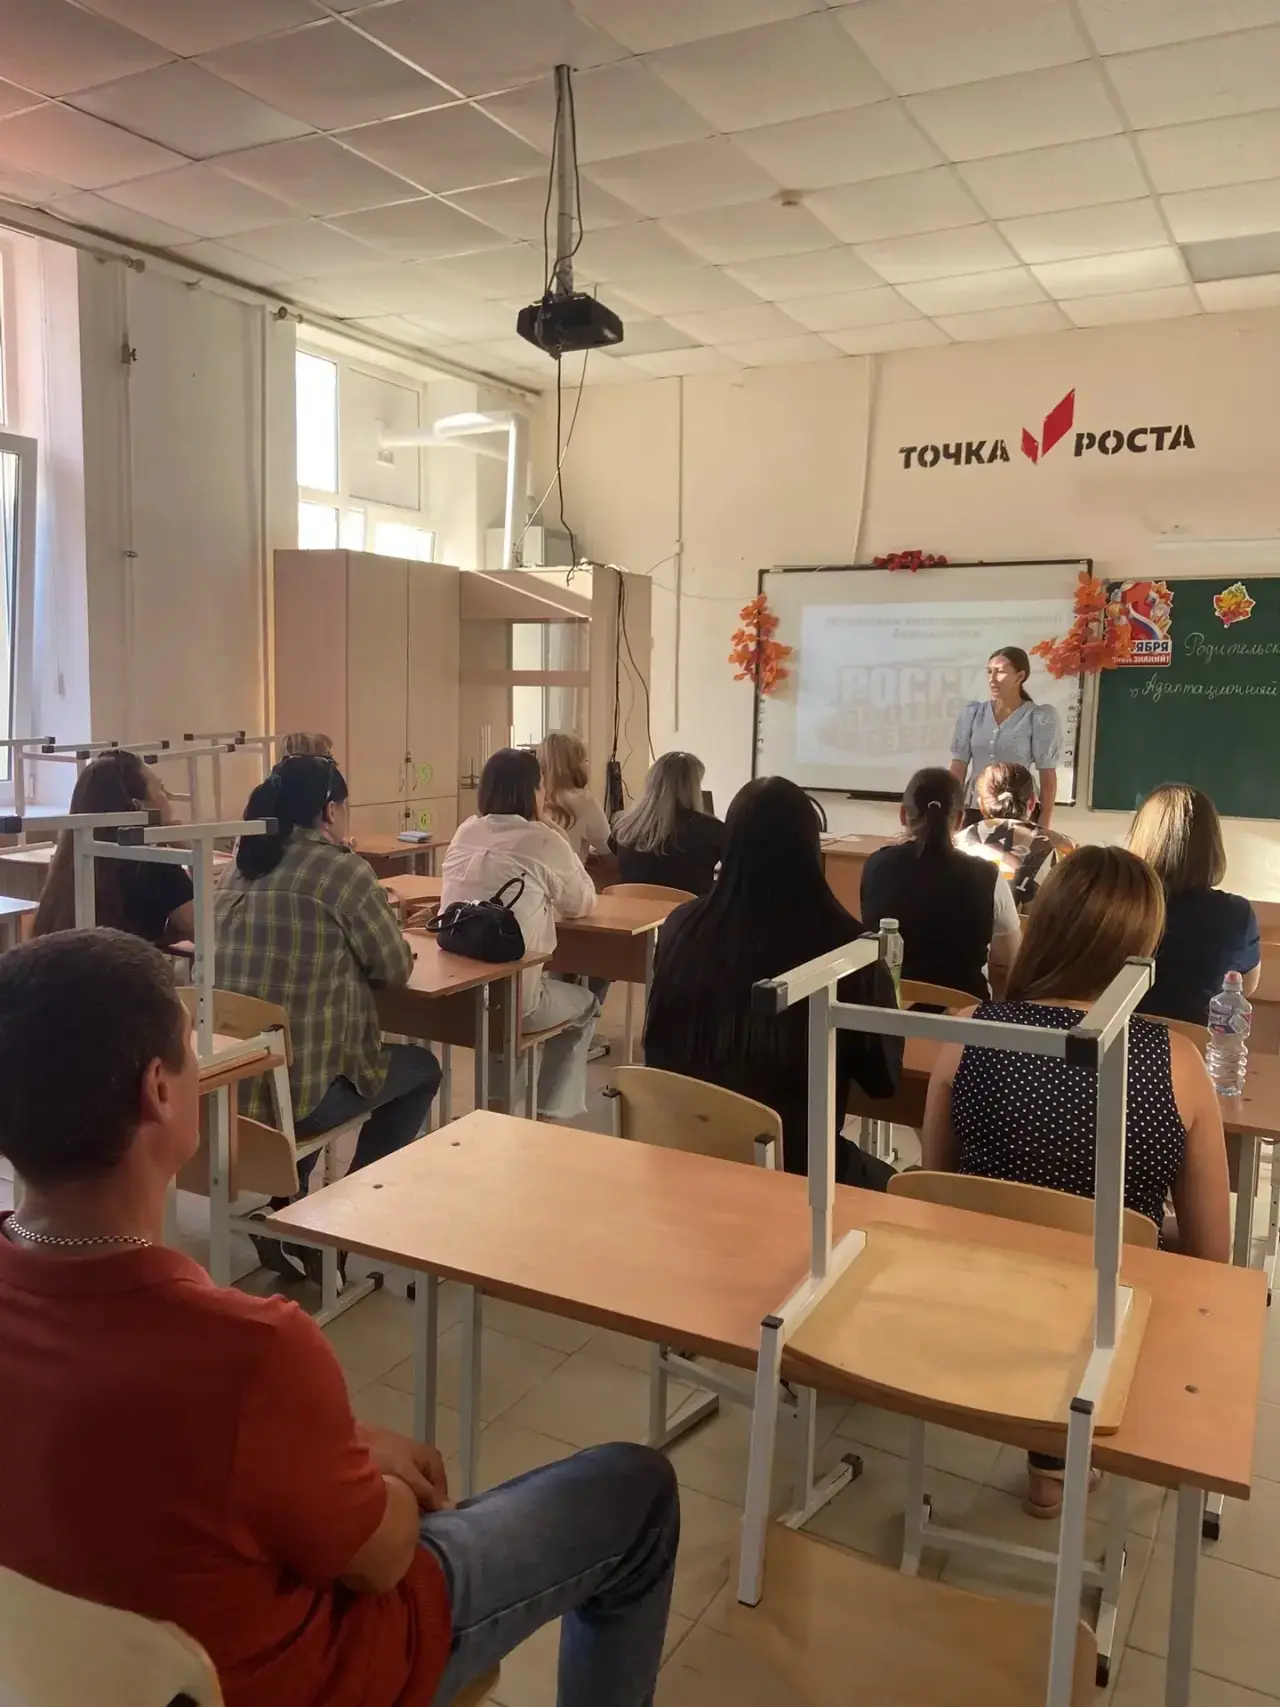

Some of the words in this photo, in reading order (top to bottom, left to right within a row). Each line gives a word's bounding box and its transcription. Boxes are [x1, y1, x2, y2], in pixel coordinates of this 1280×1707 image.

[898, 439, 1010, 469] ТОЧКА
[1073, 424, 1196, 457] РОСТА
[1132, 641, 1169, 652] ЯБРЯ
